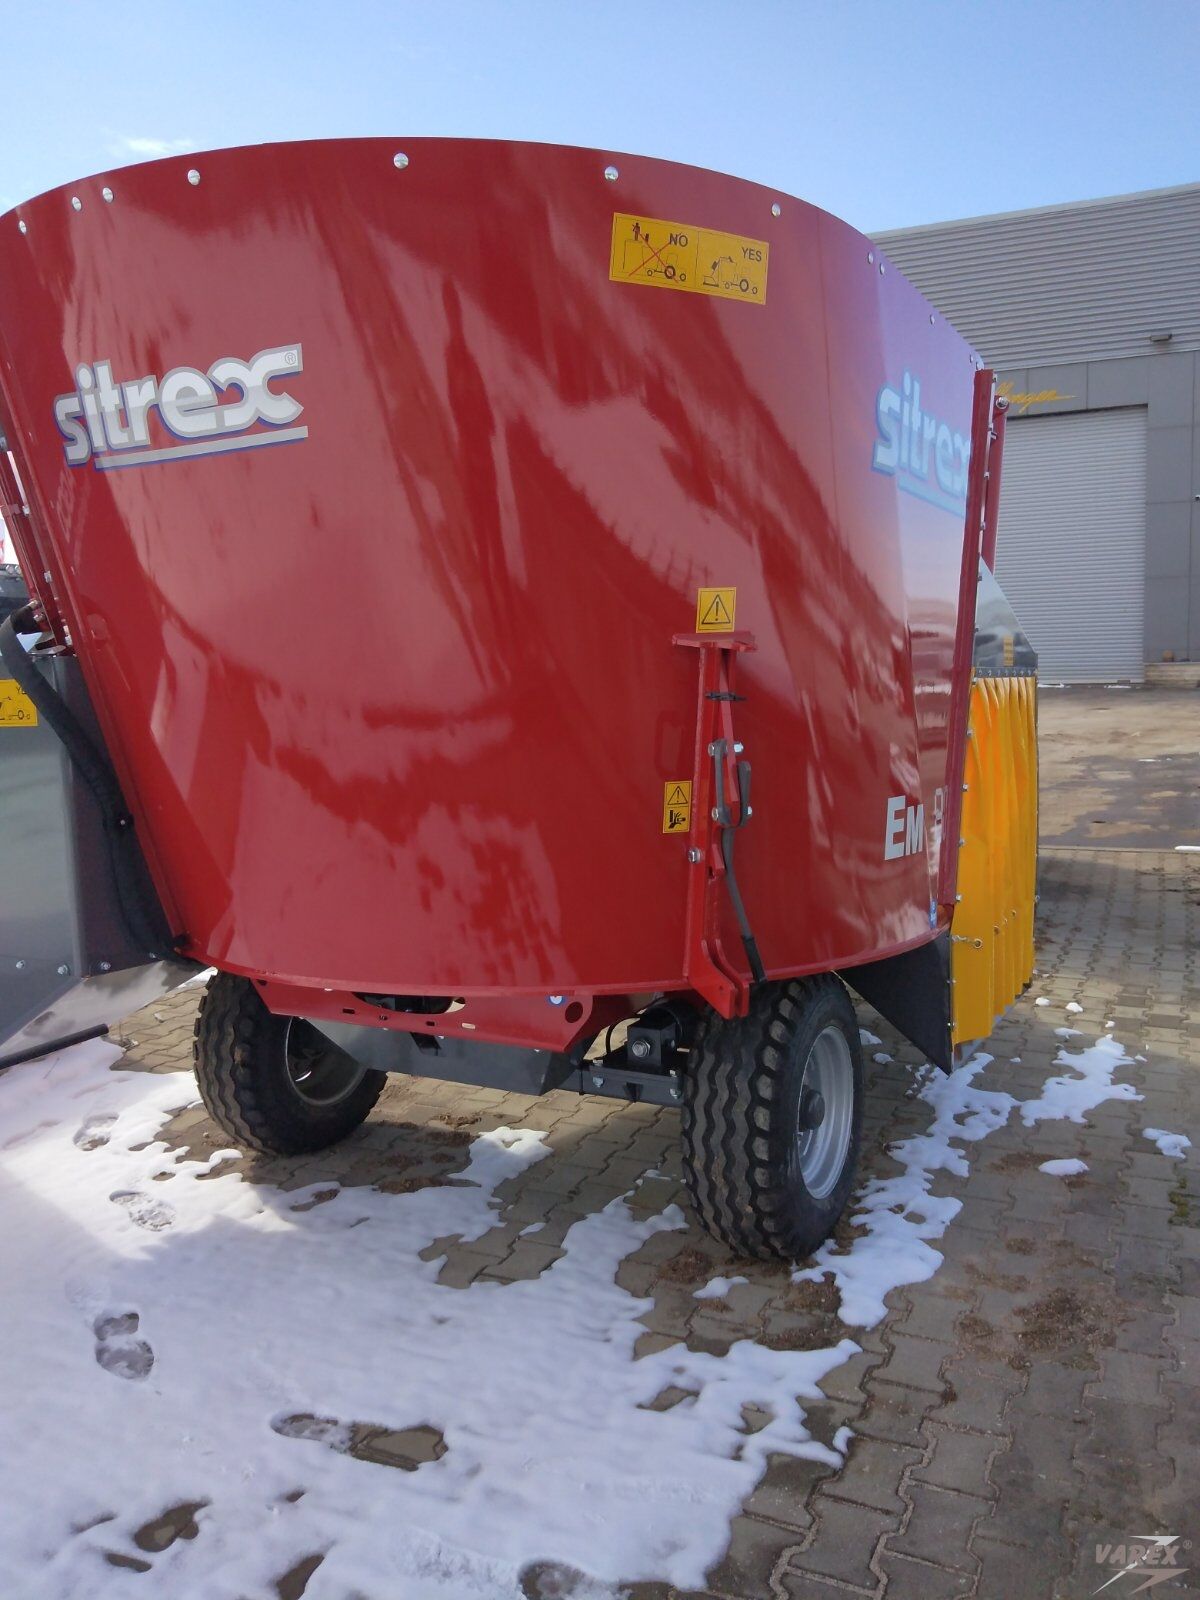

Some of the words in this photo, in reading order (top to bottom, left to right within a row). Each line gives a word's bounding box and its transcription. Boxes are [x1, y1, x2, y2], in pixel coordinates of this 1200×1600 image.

[669, 233, 689, 248] NO
[742, 247, 762, 262] YES
[885, 795, 924, 860] EM
